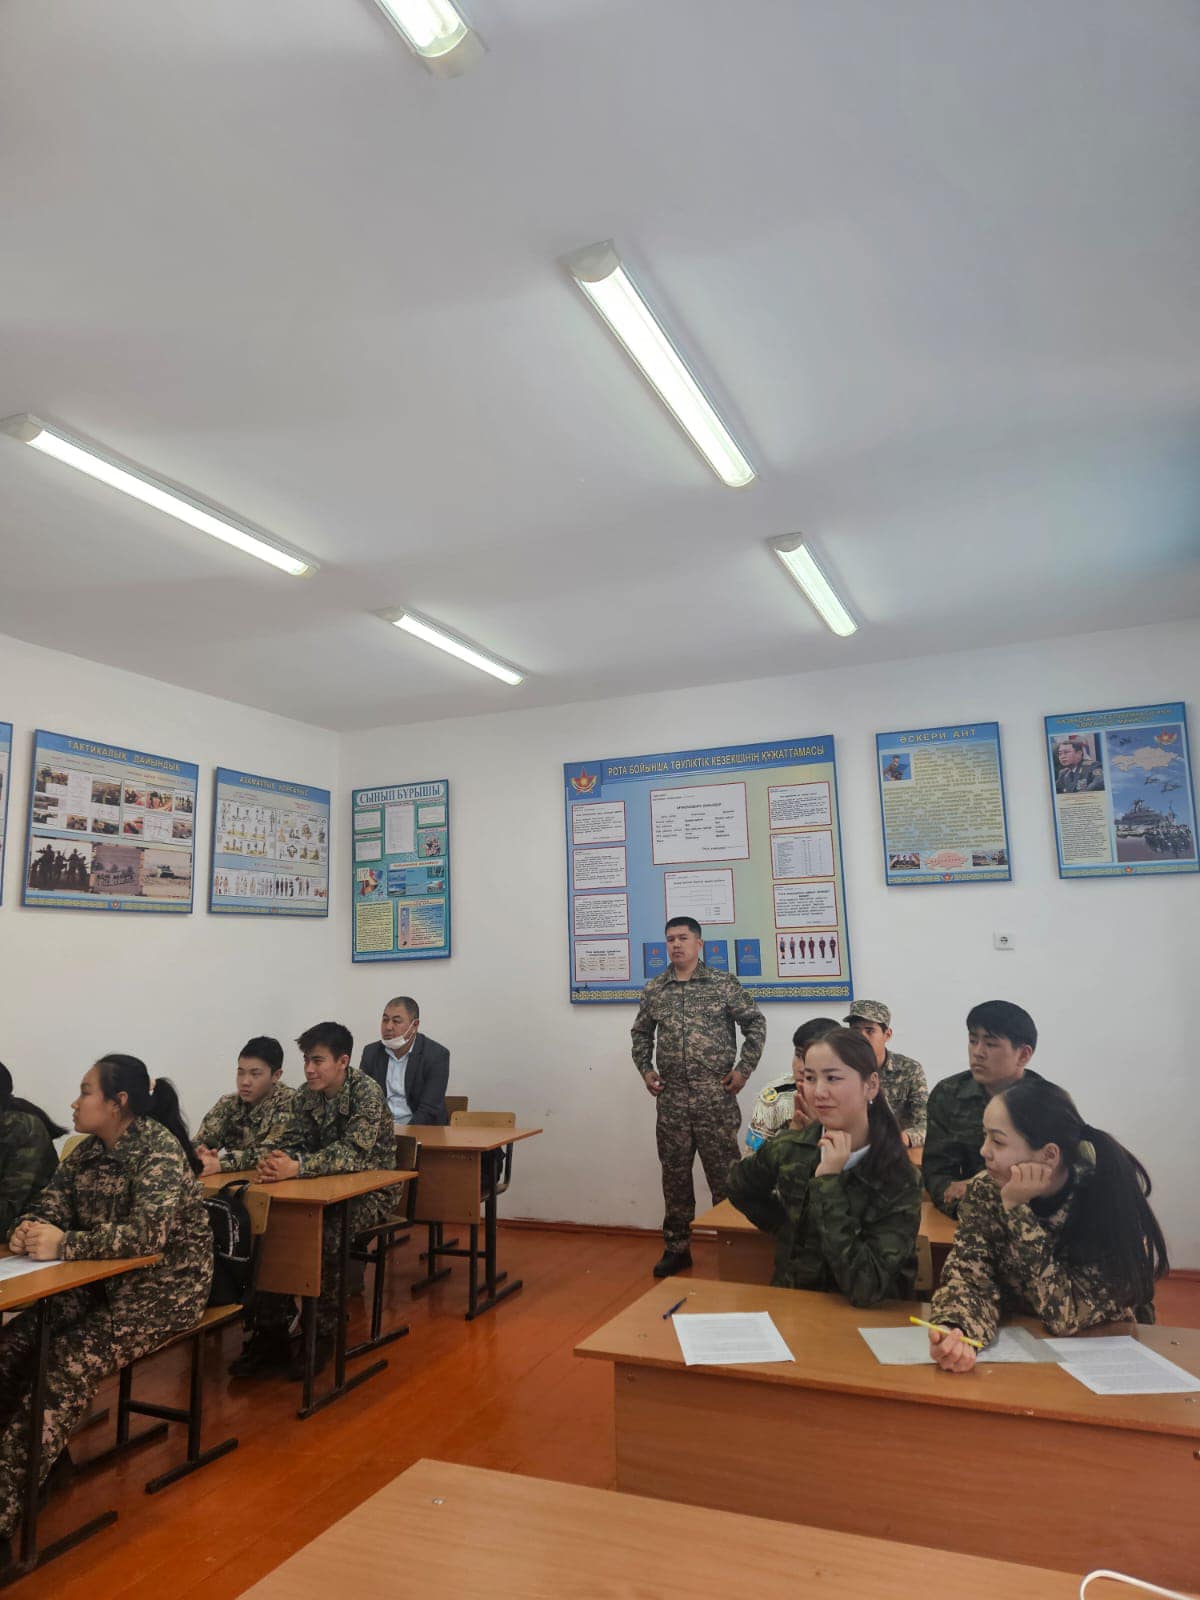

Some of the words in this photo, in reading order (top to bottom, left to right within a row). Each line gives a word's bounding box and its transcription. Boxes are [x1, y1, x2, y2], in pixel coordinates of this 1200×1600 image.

[899, 732, 946, 744] ӘСКЕРИ
[953, 728, 976, 738] АНТ
[608, 766, 628, 777] РОТА
[360, 791, 395, 804] СЫНЫП
